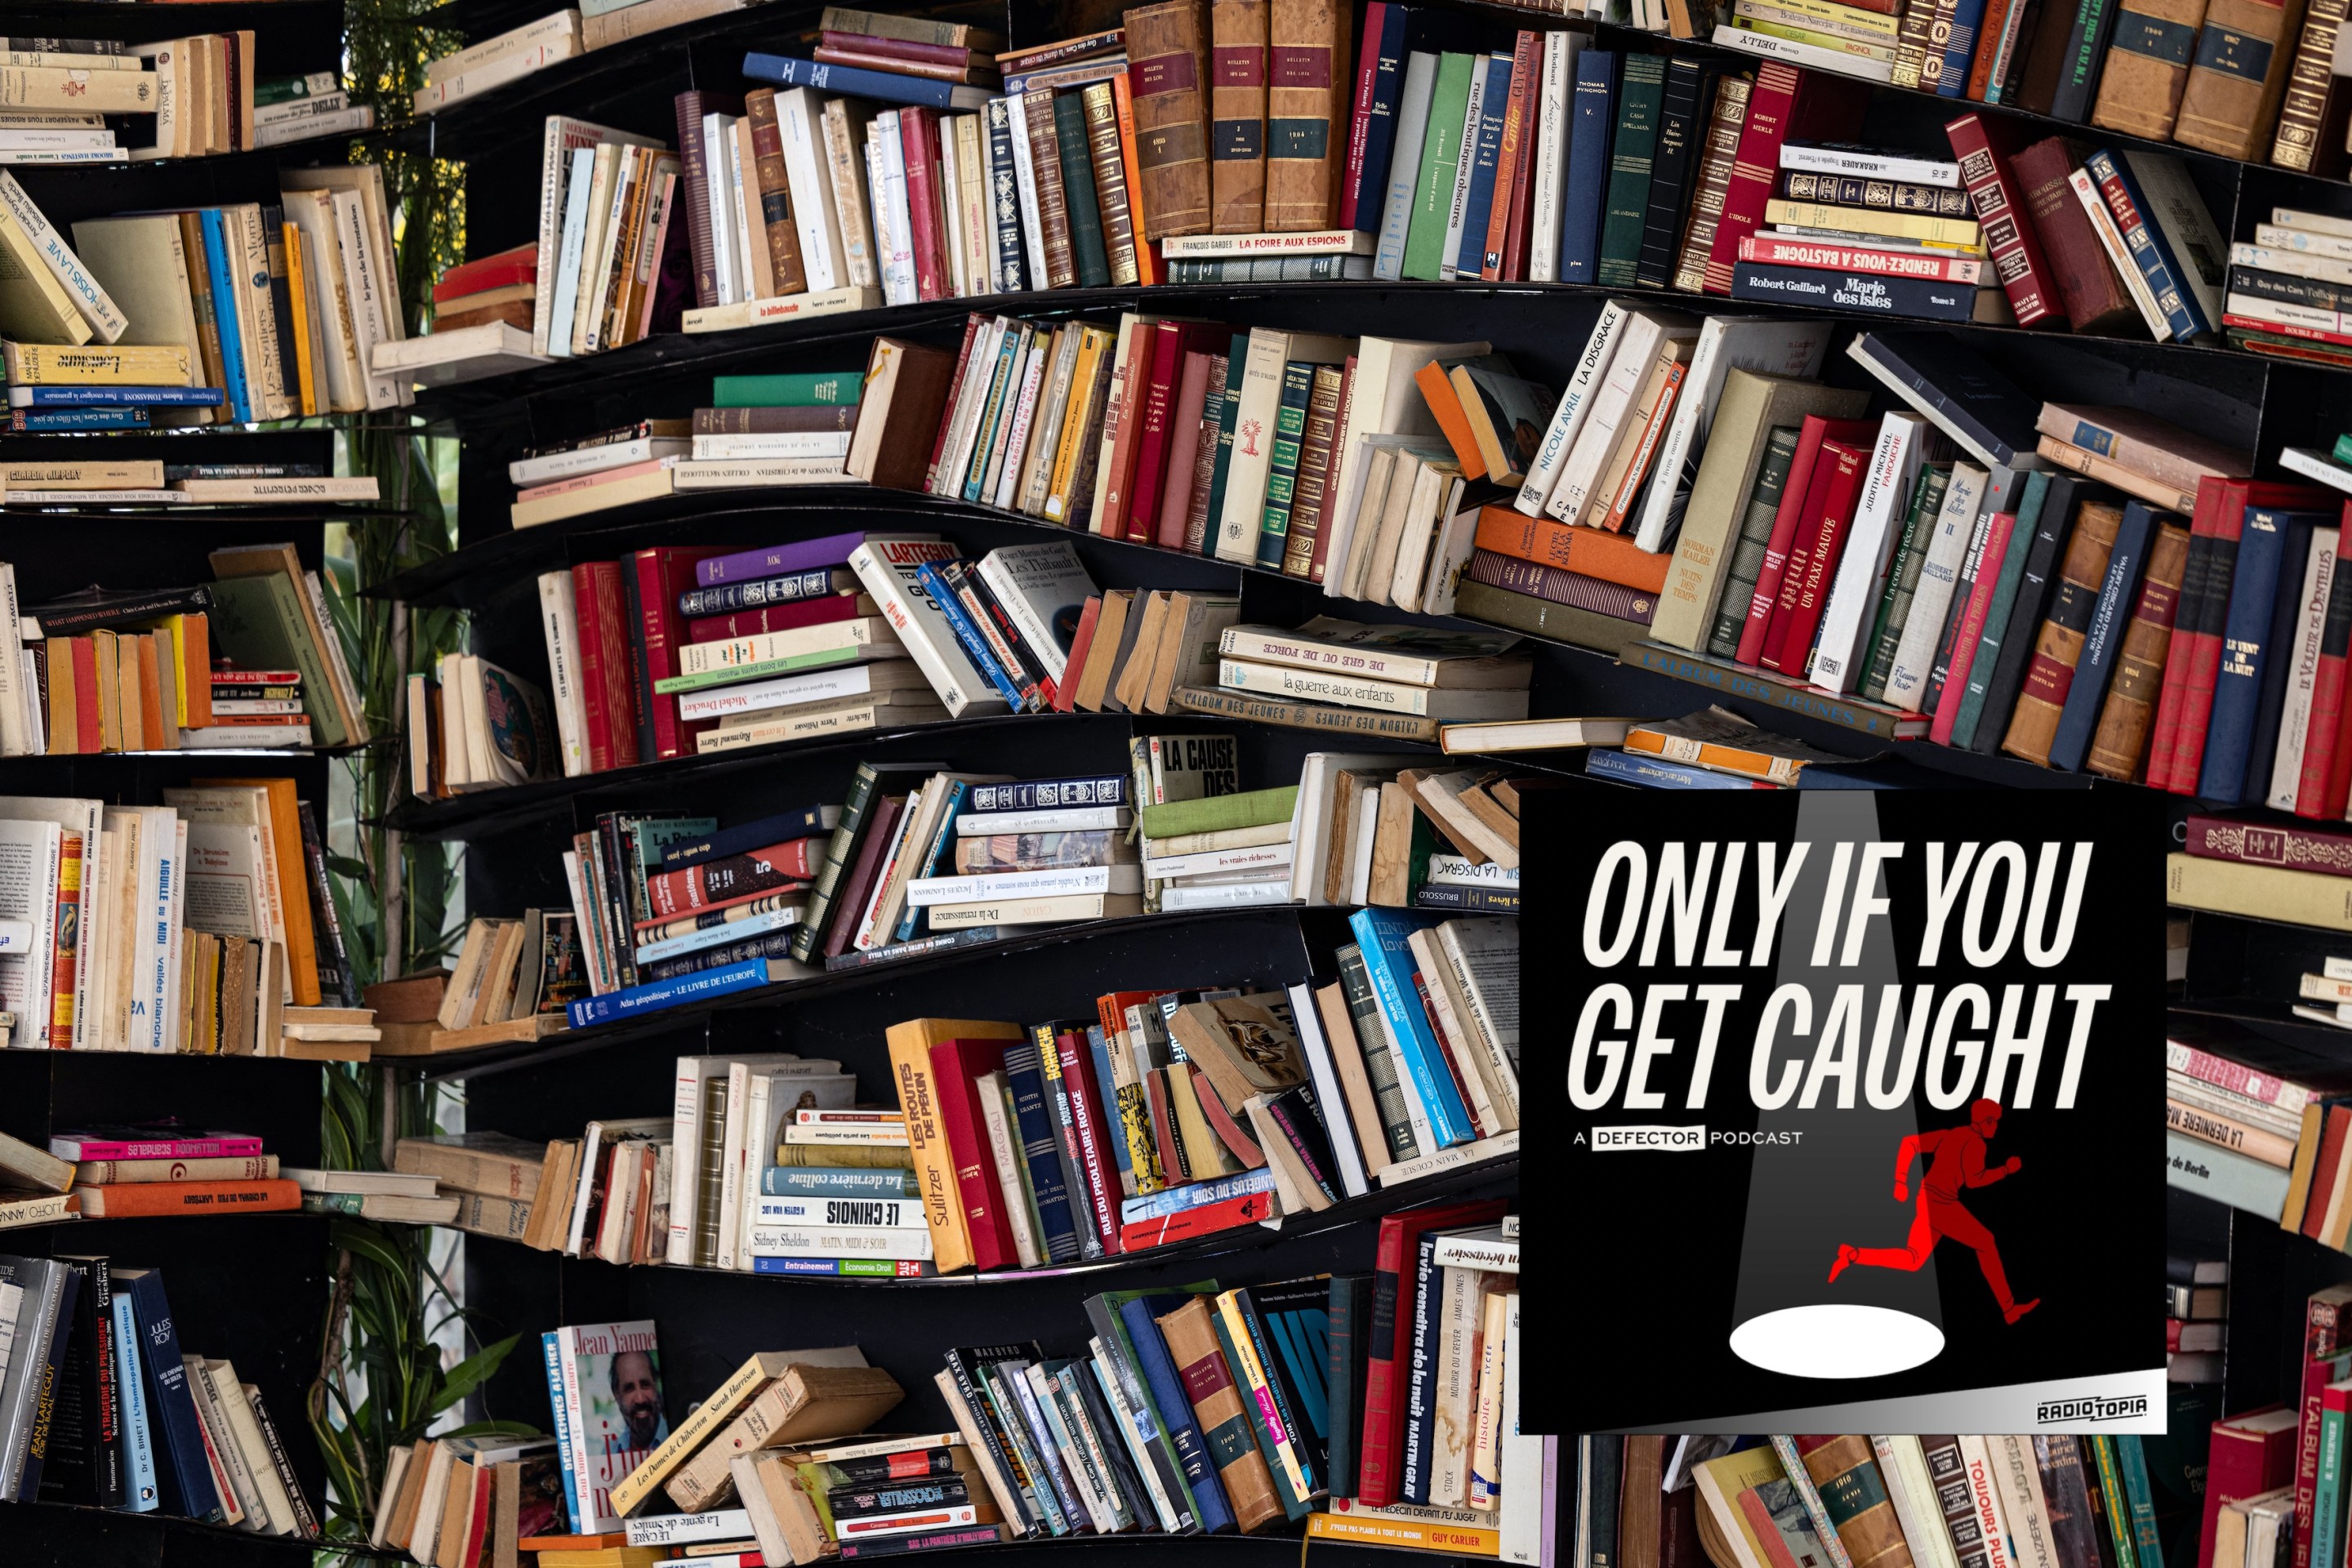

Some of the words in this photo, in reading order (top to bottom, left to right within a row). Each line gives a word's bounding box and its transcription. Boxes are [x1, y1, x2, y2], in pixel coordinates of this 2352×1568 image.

[1739, 33, 1777, 50] DELLY
[1514, 32, 1530, 74] CARLIER
[1471, 82, 1481, 101] rue
[1512, 74, 1525, 97] GUY
[1577, 87, 1607, 95] PYNCHON
[310, 96, 342, 114] DELLY
[1468, 102, 1480, 123] des
[1754, 113, 1777, 124] ROBERT
[1502, 105, 1521, 153] Carlier
[1753, 124, 1773, 135] MERLE
[1458, 123, 1477, 176] boutiques
[1450, 177, 1468, 229] obscures
[1728, 212, 1752, 224] L'IDOLE
[1183, 241, 1209, 251] FRANÇOIS
[1210, 240, 1232, 248] GARDES
[1239, 240, 1251, 248] LA
[1254, 238, 1281, 247] FOIRE
[1284, 238, 1303, 246] AUX
[1307, 235, 1345, 245] ESPIONS
[1772, 244, 1839, 265] BASTOGNE
[1841, 252, 1851, 265] A
[1852, 252, 1940, 275] RENDEZ-VOUS
[1748, 276, 1785, 290] Robert
[1785, 280, 1826, 293] Gaillard
[1844, 277, 1886, 296] Marie
[760, 307, 766, 316] la
[766, 302, 799, 315] billebaude
[57, 351, 122, 375] Louisiane
[1539, 425, 1566, 470] NICOLE
[1558, 390, 1581, 425] AVRIL
[1576, 370, 1590, 385] LA
[1584, 309, 1618, 368] DISGRACE
[1682, 537, 1715, 555] NORMAN
[1814, 517, 1837, 561] MAUVE
[880, 542, 958, 564] LARTEGUY
[1682, 547, 1709, 567] MAILER
[1679, 568, 1703, 581] NUITS
[1681, 578, 1696, 590] DES
[1806, 561, 1823, 589] TAXI
[1673, 586, 1698, 604] TEMPS
[1800, 591, 1815, 608] UN
[1263, 643, 1298, 657] FORCE
[1303, 649, 1318, 660] DE
[1321, 653, 1338, 663] OU
[1341, 656, 1365, 669] GRÉ
[1369, 660, 1384, 670] DE
[1283, 671, 1294, 688] la
[1294, 678, 1330, 697] guerre
[1332, 685, 1352, 697] aux
[1354, 682, 1396, 704] enfants
[683, 700, 717, 714] Drucker
[718, 695, 747, 709] Michel
[1163, 739, 1183, 771] LA
[1187, 739, 1235, 769] CAUSE
[158, 859, 170, 900] AIGUILLE
[1419, 890, 1458, 901] BRUSSOLO
[158, 906, 165, 915] DU
[934, 910, 977, 922] renaissance
[978, 910, 986, 920] la
[987, 909, 999, 920] De
[157, 921, 167, 944] MIDI
[155, 956, 165, 993] vallée
[619, 998, 635, 1009] Atlas
[635, 989, 671, 1005] géopolitique
[676, 985, 687, 995] LE
[687, 979, 710, 991] LIVRE
[710, 977, 720, 987] DE
[720, 968, 756, 984] L'EUROPE
[153, 997, 163, 1047] blanche
[1036, 1025, 1062, 1080] BORNICHE
[899, 1062, 920, 1121] ROUTES
[1071, 1089, 1088, 1128] ROUGE
[922, 1117, 935, 1139] DE
[2180, 1110, 2230, 1143] DERNIERE
[911, 1123, 926, 1150] LES
[2226, 1127, 2245, 1148] LA
[1080, 1126, 1103, 1196] PROLETAIRE
[787, 1172, 827, 1188] colline
[829, 1174, 882, 1190] dernière
[884, 1175, 902, 1189] La
[928, 1165, 949, 1227] Sulitzer
[1191, 1187, 1214, 1204] SOIR
[1214, 1183, 1230, 1199] DU
[826, 1200, 882, 1225] CHINOIS
[1096, 1196, 1107, 1212] DU
[885, 1203, 898, 1226] LE
[1099, 1211, 1112, 1236] RUE
[785, 1260, 834, 1272] Entraînement
[844, 1260, 875, 1272] Économie
[875, 1263, 892, 1272] Droit
[1442, 1246, 1504, 1267] bécassier
[1414, 1282, 1431, 1347] renaîtra
[149, 1318, 172, 1337] JULES
[96, 1316, 108, 1366] PRESIDENT
[154, 1330, 171, 1346] ROY
[574, 1328, 608, 1356] Jean
[609, 1326, 657, 1354] Yanne
[546, 1343, 559, 1366] MER
[100, 1369, 109, 1383] DU
[550, 1366, 561, 1381] LA
[36, 1363, 55, 1423] LARTEGUY
[552, 1381, 562, 1391] A
[100, 1384, 111, 1427] TRAGEDIE
[1410, 1385, 1424, 1417] nuit
[554, 1395, 568, 1439] FEMMES
[1477, 1396, 1490, 1449] histoire
[30, 1425, 43, 1457] JEAN
[103, 1428, 112, 1441] LA
[1406, 1419, 1419, 1467] MARTIN
[559, 1441, 573, 1470] DEUX
[1404, 1466, 1416, 1498] GRAY
[1967, 1459, 1998, 1535] TOUJOURS
[631, 1517, 663, 1532] Smiley
[665, 1519, 676, 1530] de
[679, 1514, 705, 1527] gente
[706, 1516, 719, 1526] La
[1330, 1522, 1348, 1532] J'PEUX
[1348, 1525, 1358, 1533] PAS
[1358, 1526, 1376, 1535] PLAIRE
[1377, 1527, 1382, 1535] À
[1403, 1530, 1422, 1539] MONDE
[1432, 1533, 1447, 1544] GUY
[1450, 1535, 1480, 1547] CARLIER
